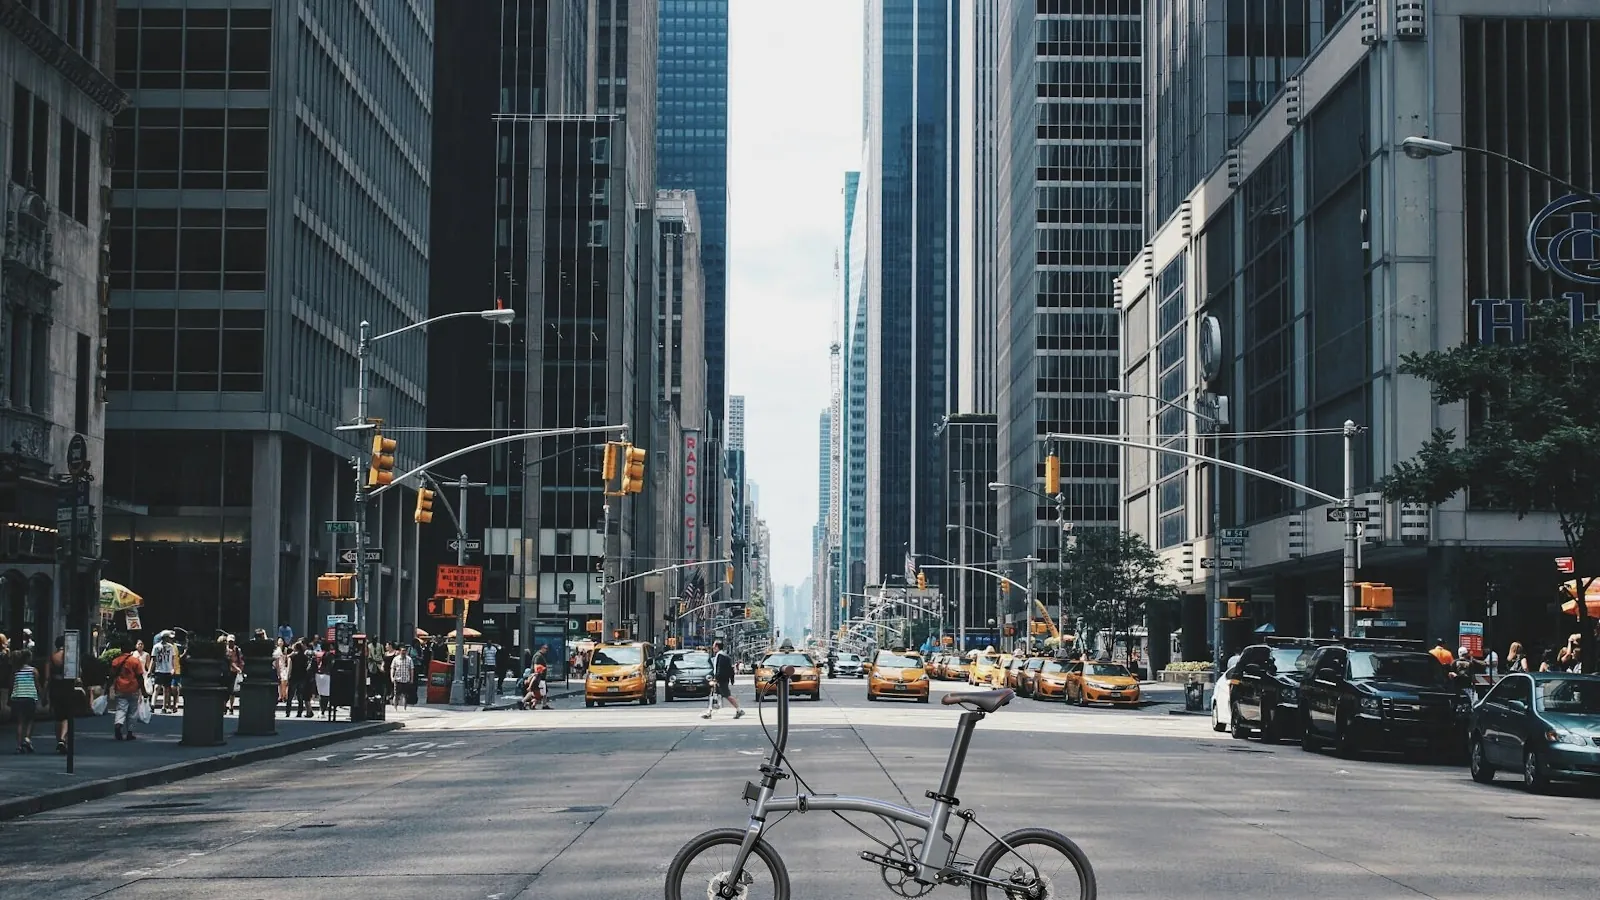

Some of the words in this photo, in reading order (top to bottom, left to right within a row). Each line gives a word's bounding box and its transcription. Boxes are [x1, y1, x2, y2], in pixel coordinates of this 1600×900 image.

[685, 436, 697, 505] RADIO
[333, 523, 342, 532] 54
[1234, 529, 1243, 538] 54
[685, 517, 697, 570] CITY
